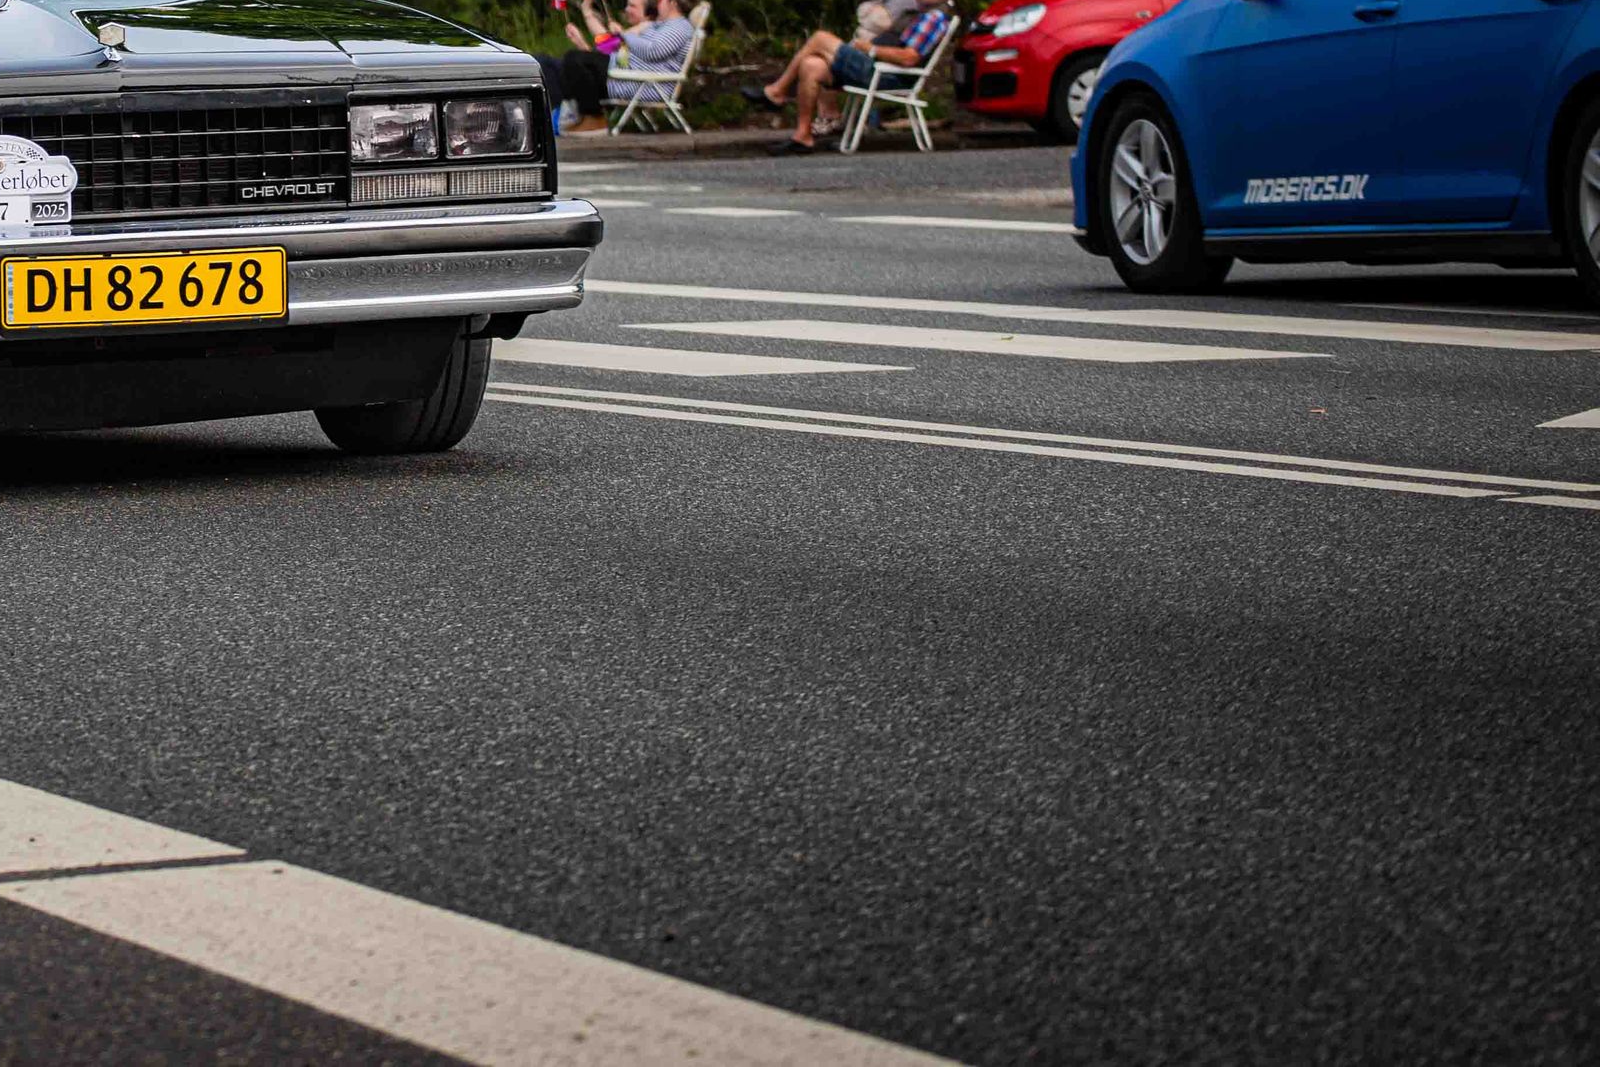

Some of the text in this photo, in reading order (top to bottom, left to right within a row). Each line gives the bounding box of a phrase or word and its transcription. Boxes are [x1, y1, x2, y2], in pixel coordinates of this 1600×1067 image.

[242, 182, 336, 199] CHEVROLET
[1244, 174, 1369, 204] MOBERGS.DK
[35, 203, 66, 218] 2025
[26, 259, 264, 313] DH 82 678
